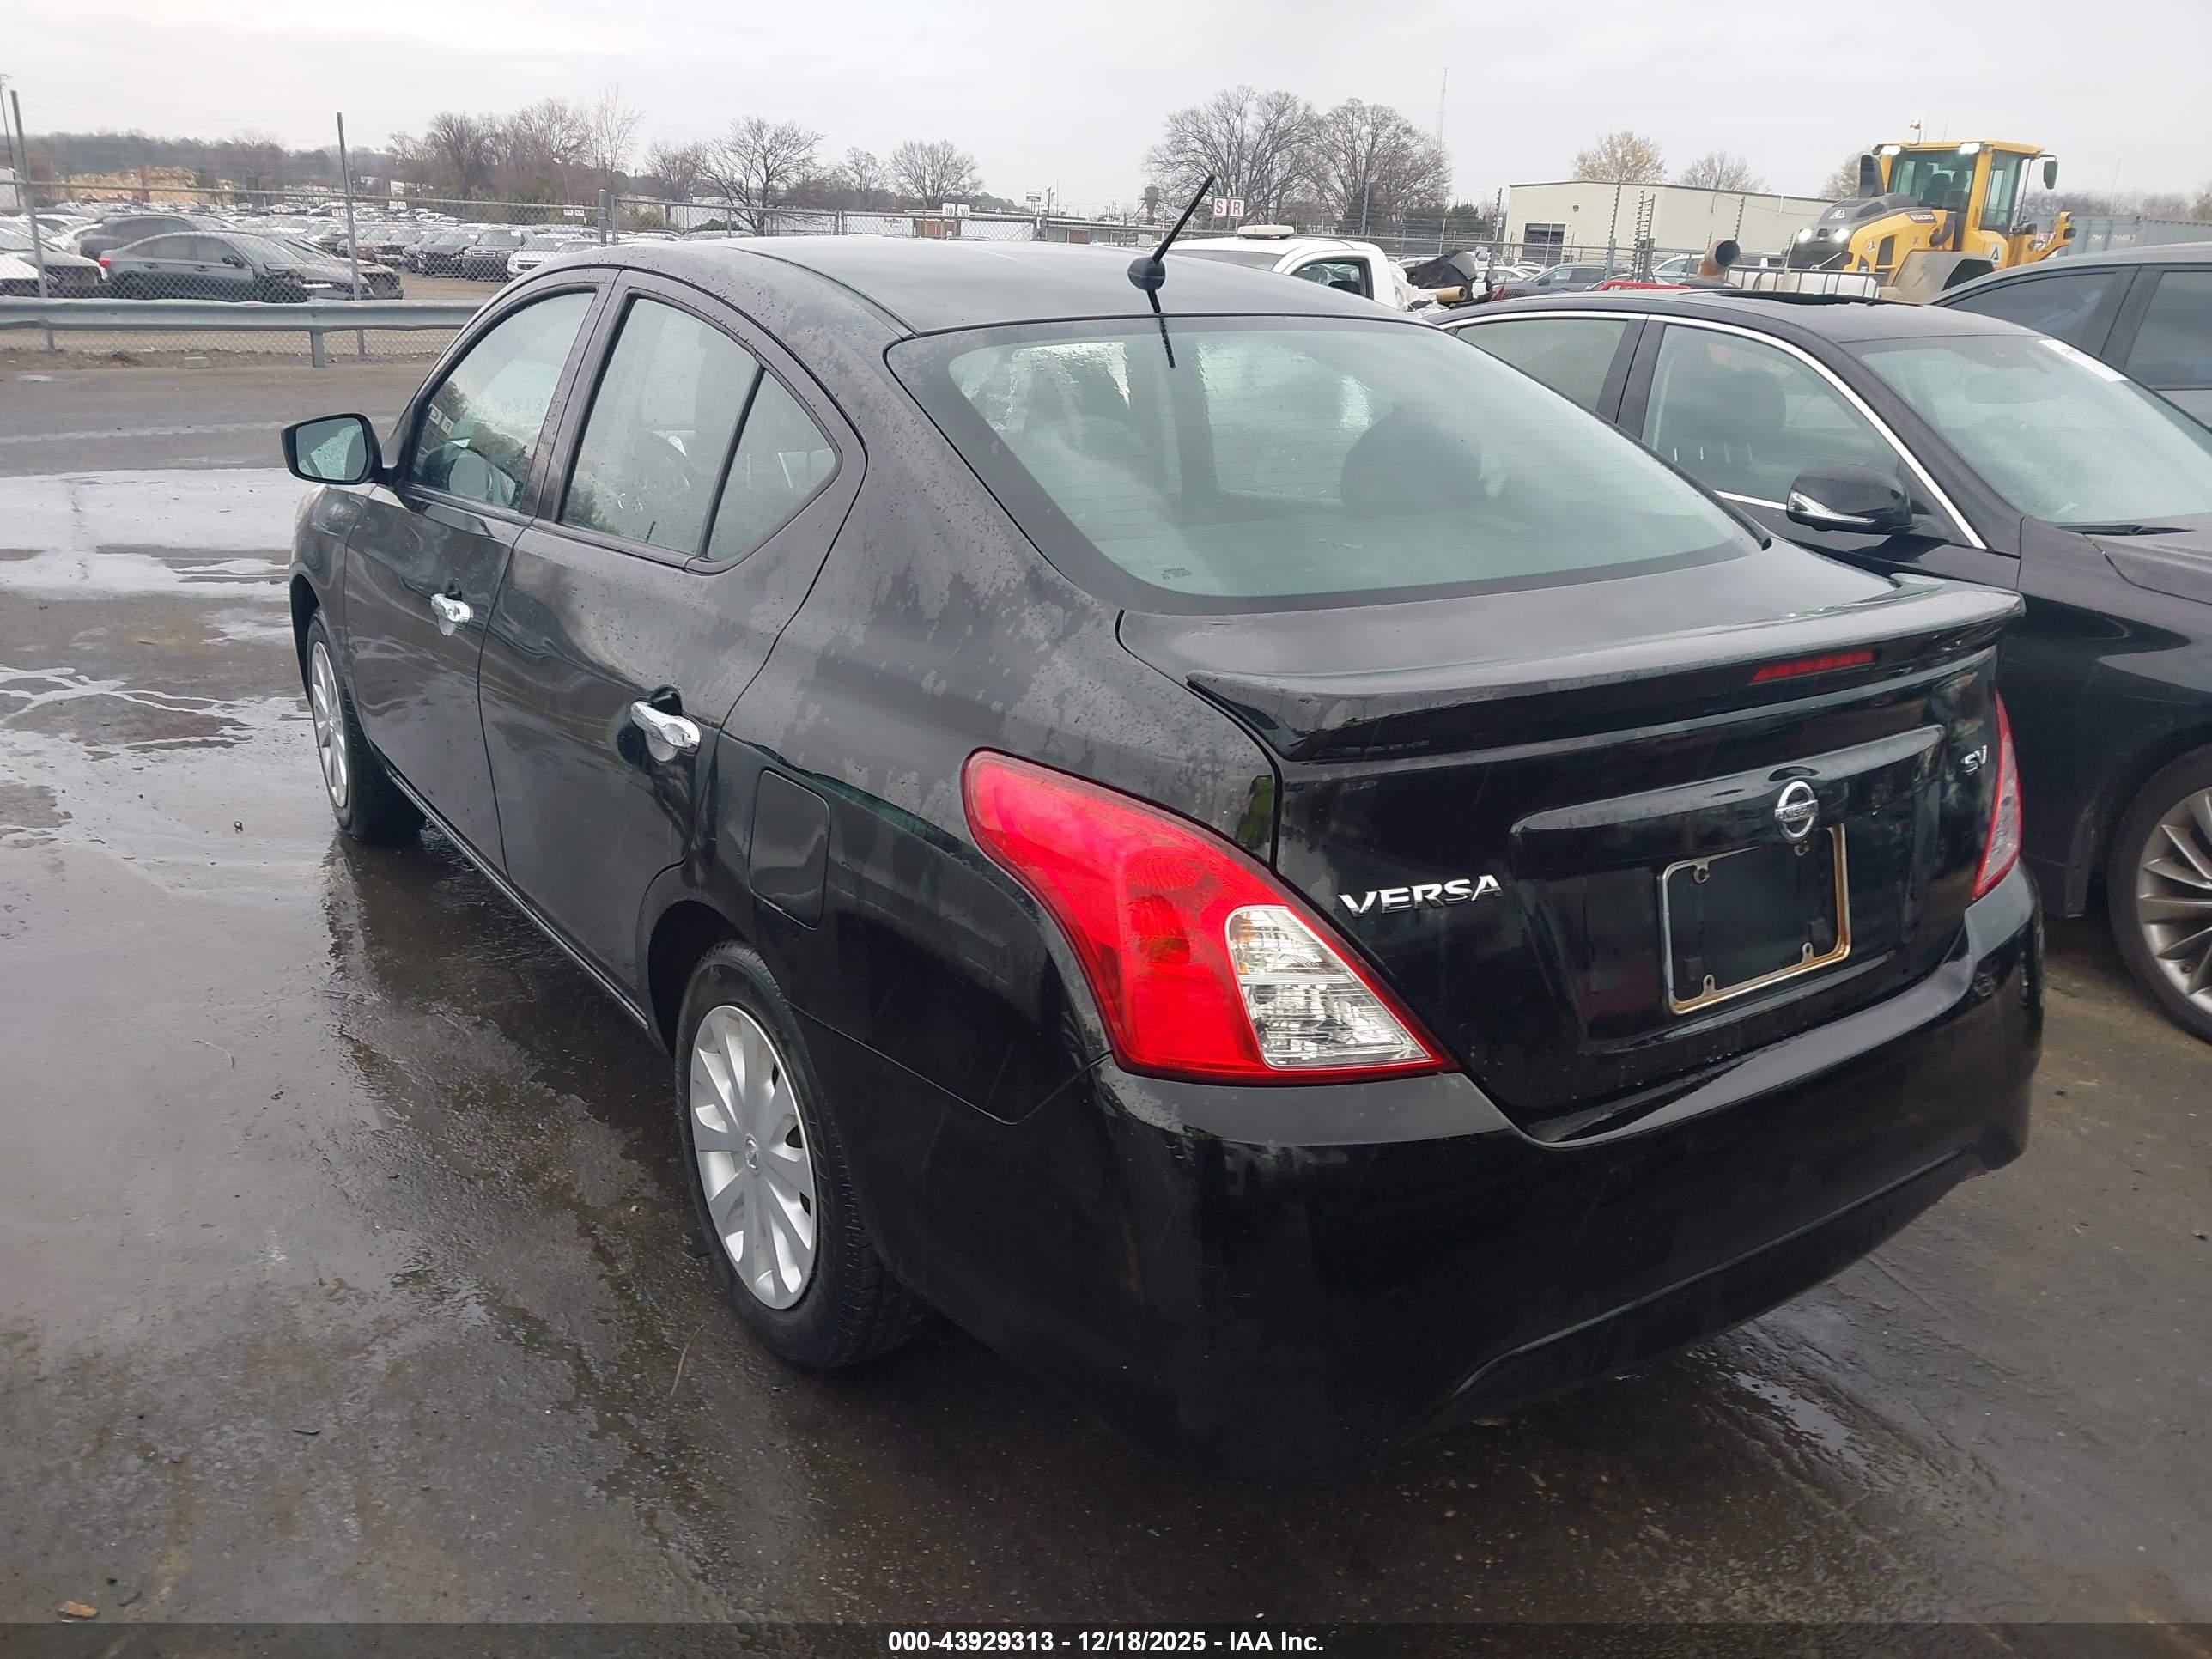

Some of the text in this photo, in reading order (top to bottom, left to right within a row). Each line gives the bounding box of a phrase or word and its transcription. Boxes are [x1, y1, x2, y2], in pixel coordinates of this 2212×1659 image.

[945, 207, 953, 216] 10
[1215, 199, 1241, 215] S R
[1963, 744, 1987, 774] SV
[1338, 874, 1503, 918] VERSA
